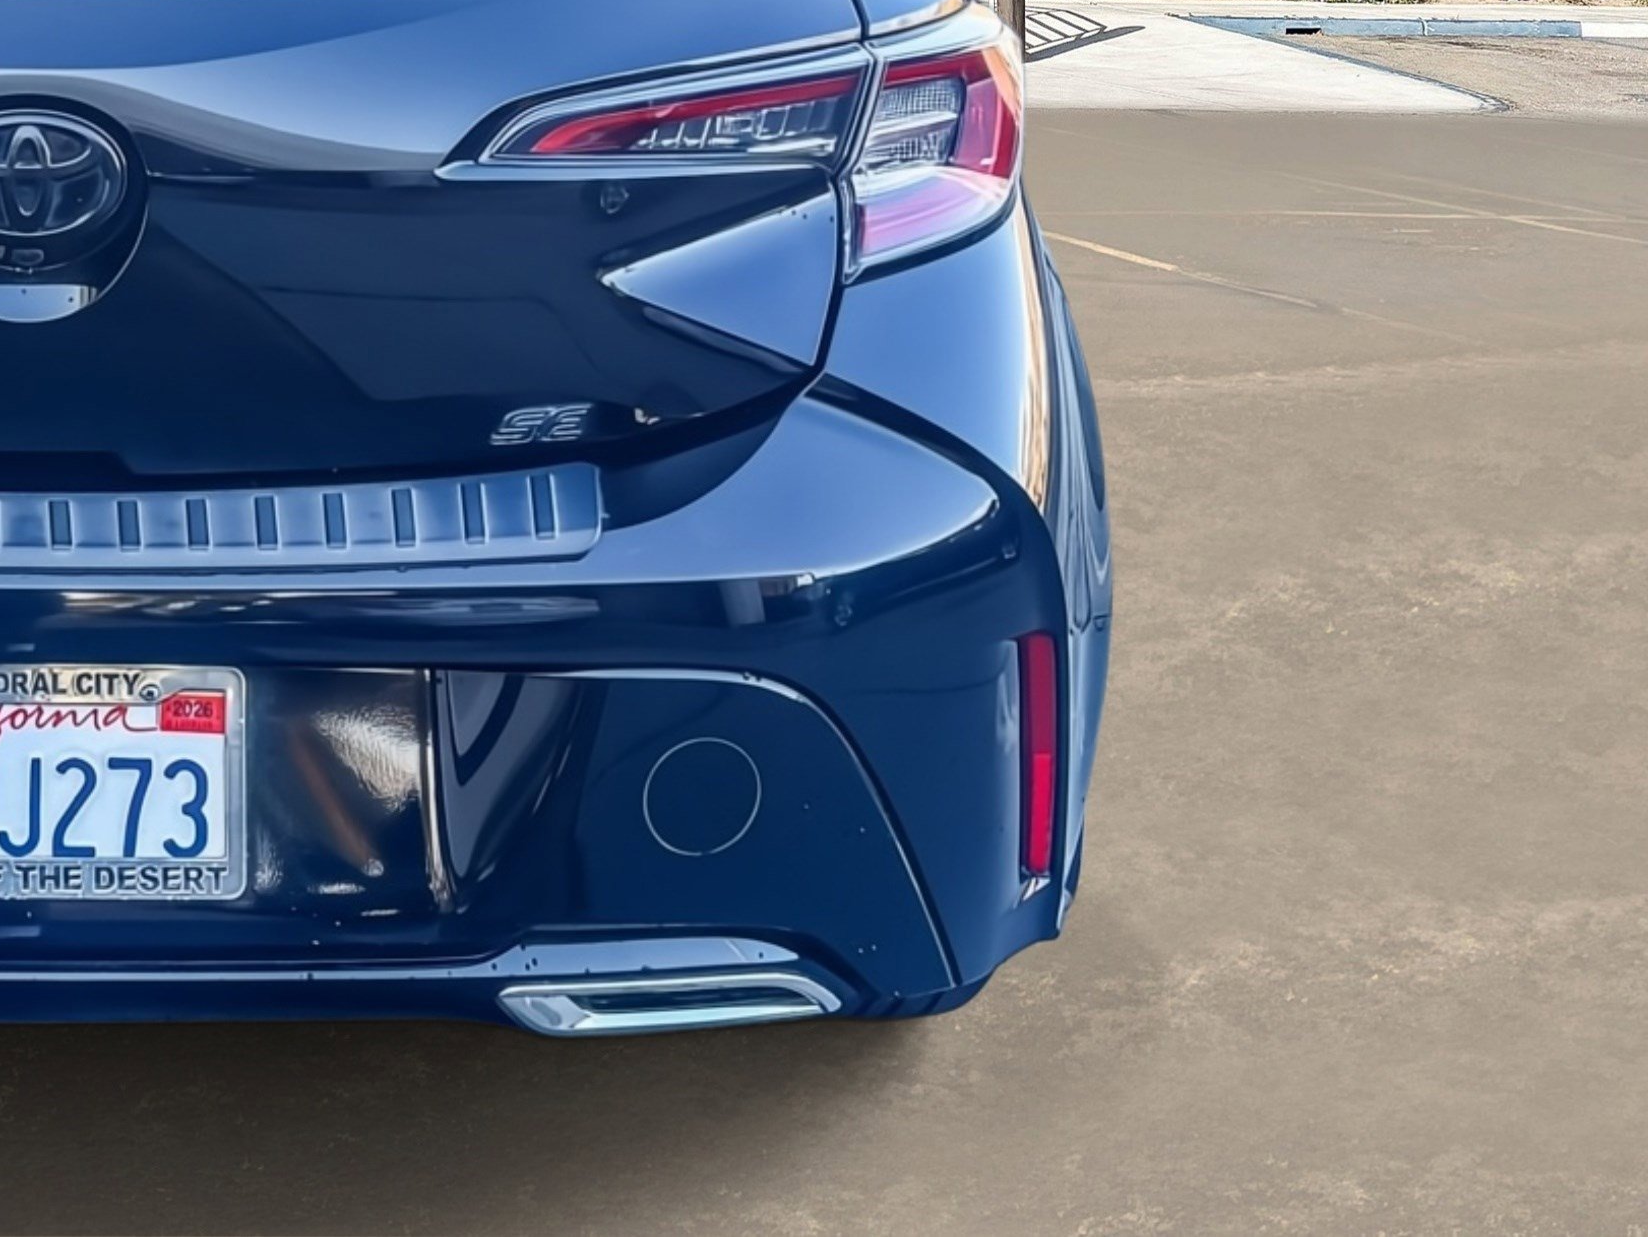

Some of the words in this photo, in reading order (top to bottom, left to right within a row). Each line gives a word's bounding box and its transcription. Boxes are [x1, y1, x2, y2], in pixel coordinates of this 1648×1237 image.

[489, 402, 594, 445] SE
[75, 671, 140, 696] CITY
[172, 699, 214, 718] 2026
[21, 864, 84, 891] THE
[94, 864, 229, 891] DESERT
